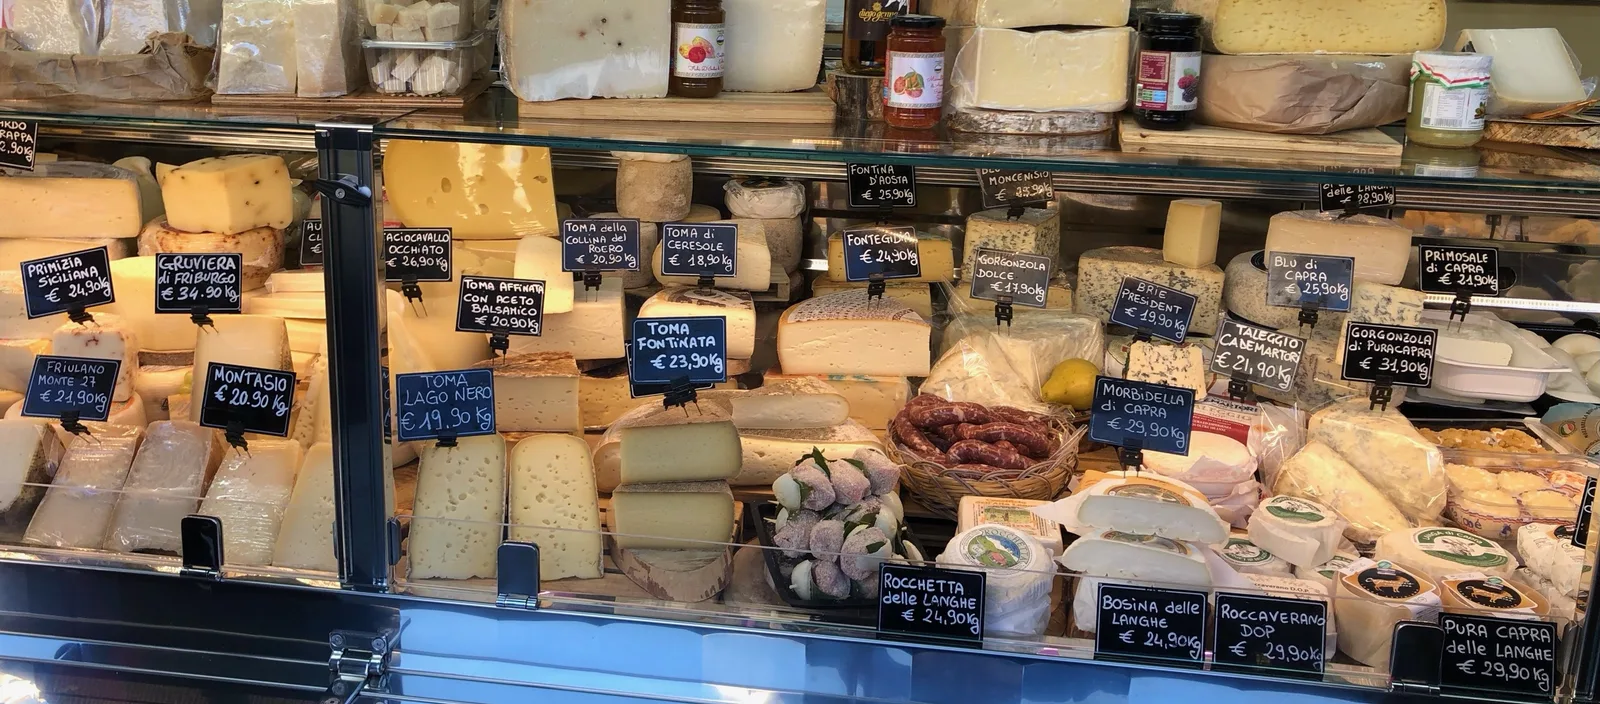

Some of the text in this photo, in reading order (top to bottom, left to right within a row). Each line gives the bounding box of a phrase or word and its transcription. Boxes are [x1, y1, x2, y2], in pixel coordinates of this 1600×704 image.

[869, 174, 908, 186] D'AOSTA
[861, 189, 873, 201] €
[994, 188, 1007, 201] €
[1326, 186, 1354, 198] delle
[565, 222, 627, 233] TOMA della
[666, 227, 714, 239] TOMA di
[611, 233, 626, 242] del
[588, 244, 623, 254] ROERO
[667, 240, 724, 251] CERESOLE
[385, 257, 397, 268] €
[575, 255, 585, 265] €
[668, 254, 681, 266] €
[859, 249, 873, 264] €
[1274, 256, 1318, 270] BLU di
[978, 255, 1046, 272] GORGONZOLA
[1426, 262, 1484, 274] di CAPRA
[159, 271, 171, 286] di
[976, 268, 1014, 281] DOLCE
[1284, 270, 1328, 282] CAPRA
[1438, 273, 1452, 285] €
[464, 280, 495, 291] TOMA
[990, 281, 1003, 292] €
[1284, 284, 1297, 294] €
[44, 288, 61, 303] €
[161, 286, 175, 300] €
[463, 293, 535, 306] CON ACETO
[1124, 306, 1138, 318] €
[474, 316, 486, 326] €
[647, 322, 690, 336] TOMA
[1235, 323, 1299, 349] TALEGGIO
[1351, 327, 1432, 345] GORGONZOLA
[1348, 342, 1362, 352] di
[650, 354, 667, 369] €
[1215, 352, 1232, 369] €
[1359, 356, 1373, 369] €
[38, 375, 96, 387] MONTE 27
[214, 368, 287, 392] MONTASIO
[420, 373, 469, 388] TOMA
[39, 391, 51, 404] €
[214, 386, 226, 401] €
[404, 386, 492, 406] LAGO NERO
[1101, 400, 1167, 418] di CAPRA
[400, 411, 416, 431] €
[1107, 417, 1121, 430] €
[883, 573, 964, 595] ROCCHETTA
[883, 591, 977, 610] delle LANGHE
[900, 608, 915, 622] €
[1165, 602, 1200, 615] delle
[1221, 603, 1326, 627] ROCCAVERANO
[1112, 612, 1169, 629] LANGHE
[1119, 629, 1135, 644] €
[1240, 624, 1276, 639] DOP
[1445, 619, 1551, 643] PURA CAPRA
[1228, 641, 1247, 657] €
[1445, 640, 1553, 661] delle LANGHE
[1456, 659, 1476, 675] €
